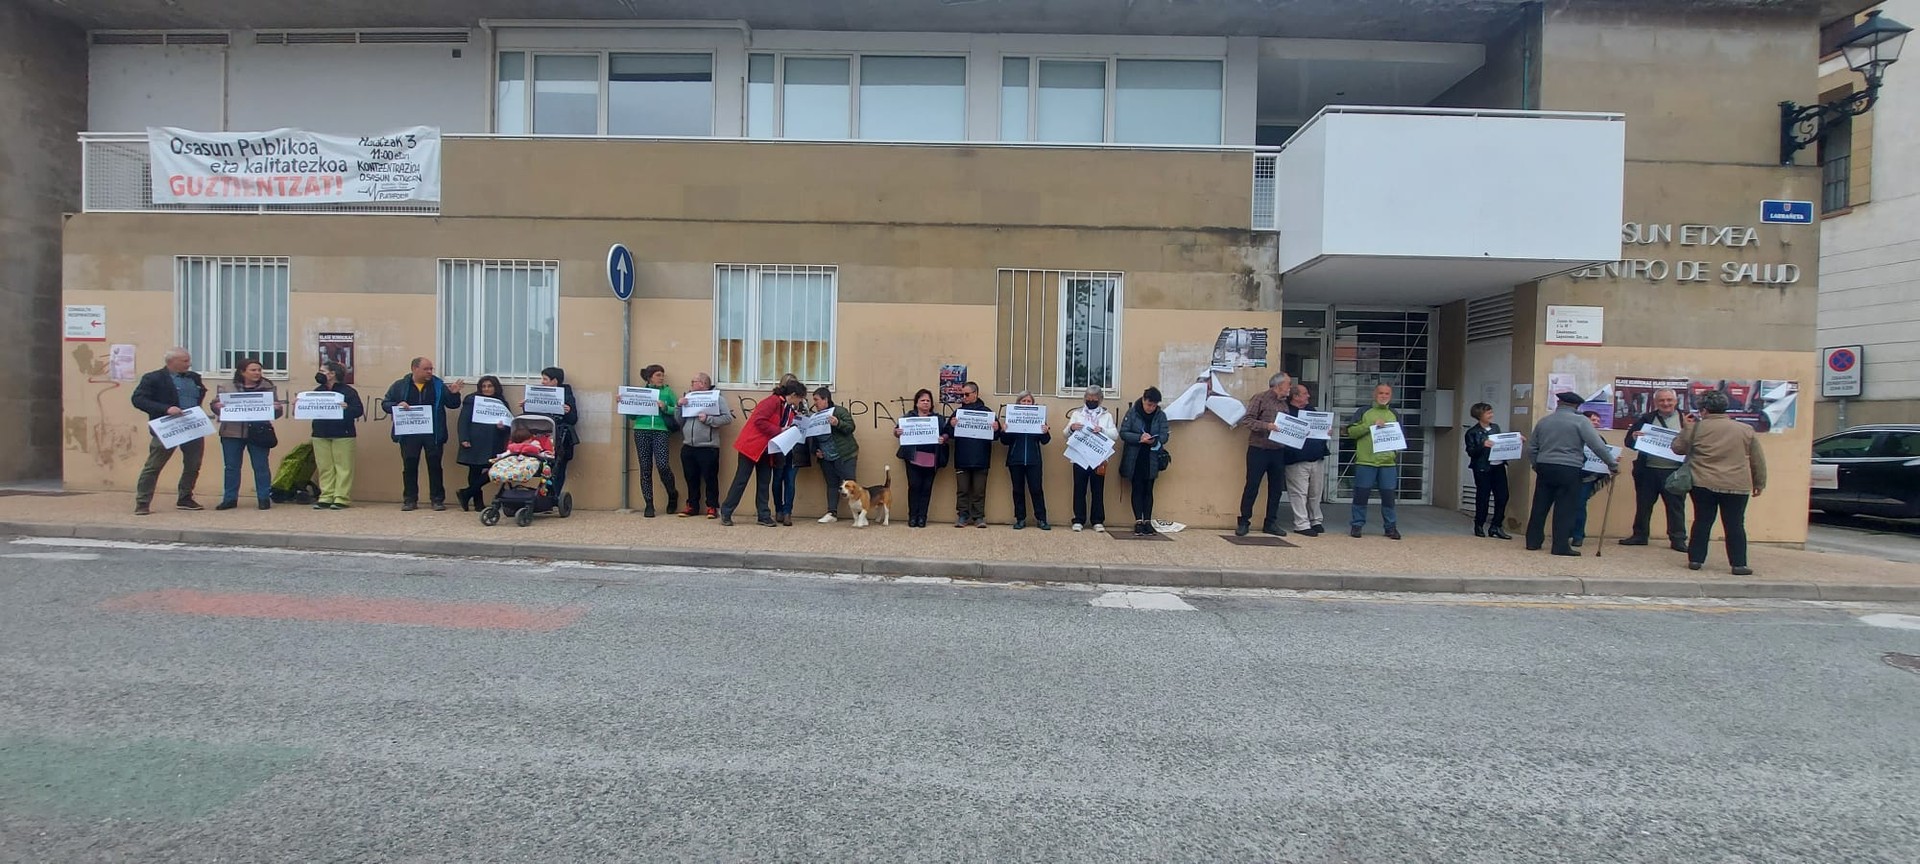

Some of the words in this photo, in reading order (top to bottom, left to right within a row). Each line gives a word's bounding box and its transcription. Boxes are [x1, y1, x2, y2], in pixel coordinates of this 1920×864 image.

[170, 136, 234, 157] Osasun
[238, 137, 319, 157] Publikoa
[405, 134, 417, 149] 3
[210, 159, 240, 173] eta
[244, 155, 348, 174] kalitatezkoa
[370, 148, 393, 160] 11:00
[169, 175, 344, 197] GUZTIENTZAT!
[1622, 222, 1672, 244] SUN
[1680, 224, 1760, 247] ETXEA
[1676, 260, 1712, 282] DE
[1720, 261, 1801, 284] SALUD
